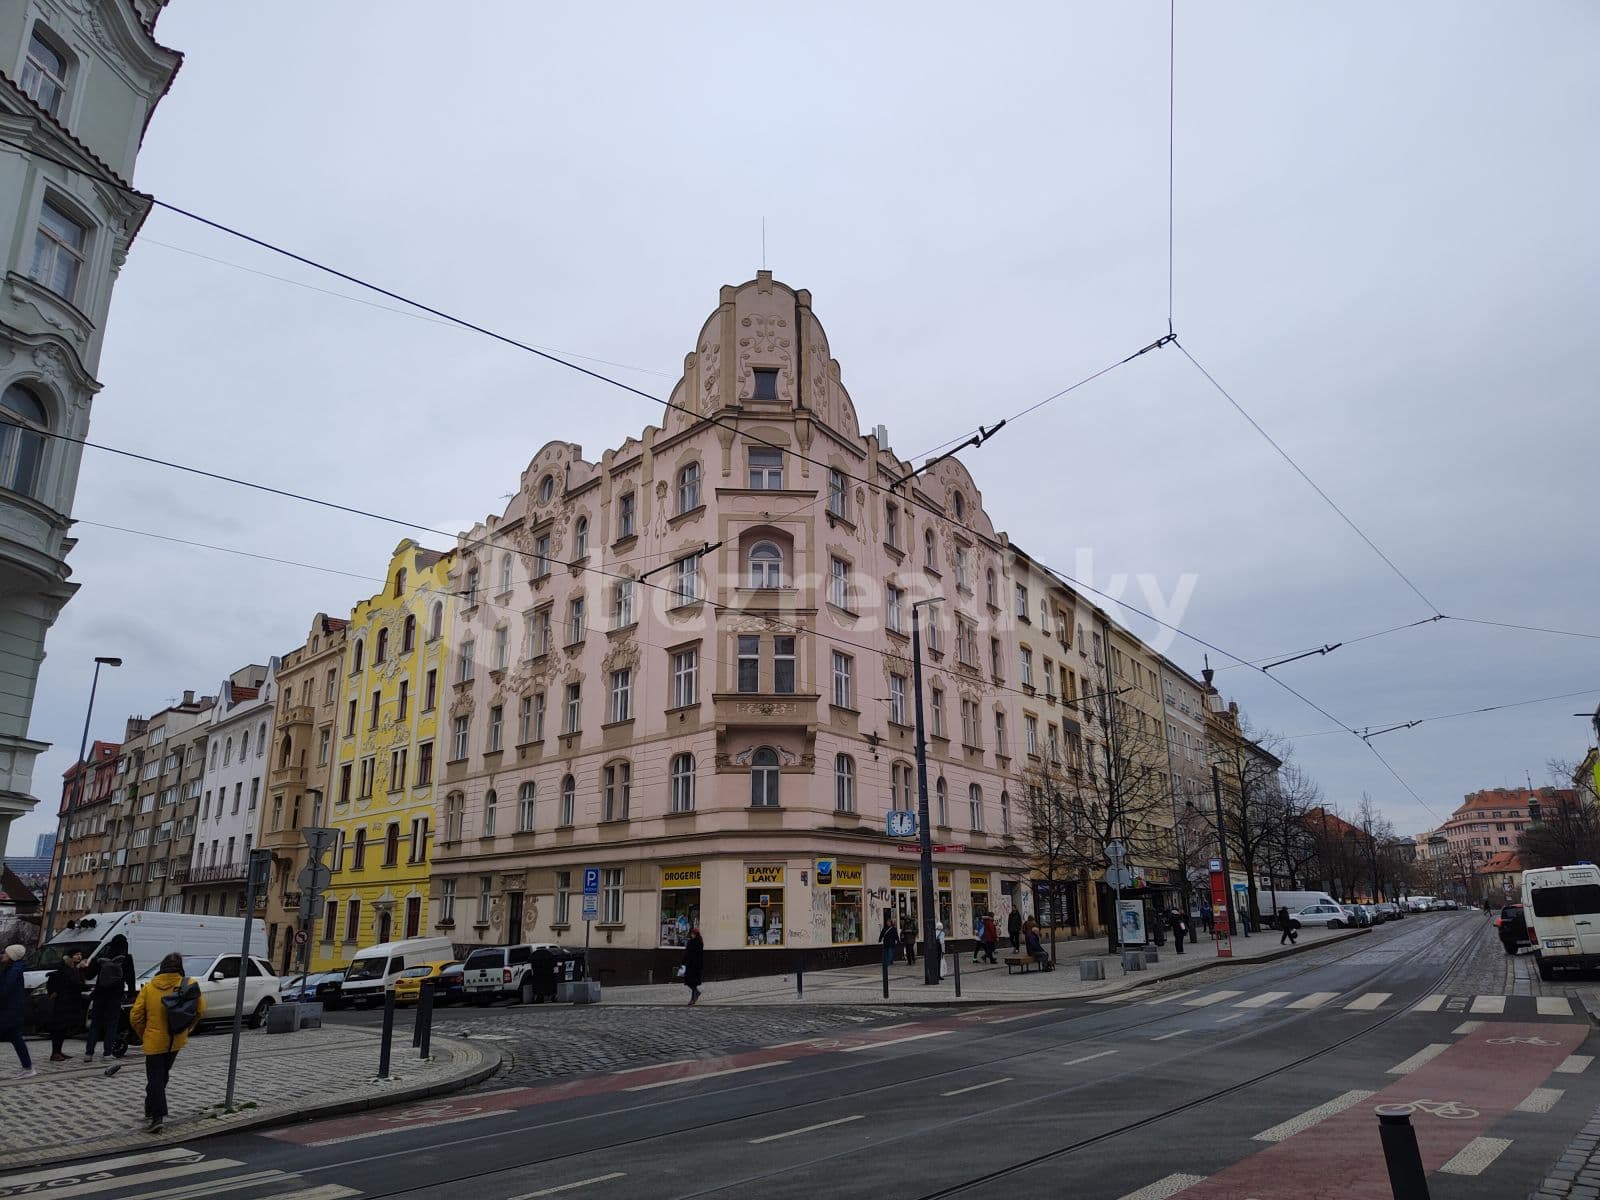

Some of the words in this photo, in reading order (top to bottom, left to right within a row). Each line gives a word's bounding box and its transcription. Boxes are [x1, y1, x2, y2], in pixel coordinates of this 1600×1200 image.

[664, 870, 701, 881] DROGERIE
[748, 866, 782, 875] BARVY
[836, 870, 862, 880] VY-LAKY
[587, 871, 597, 887] P
[751, 874, 778, 882] LAKY
